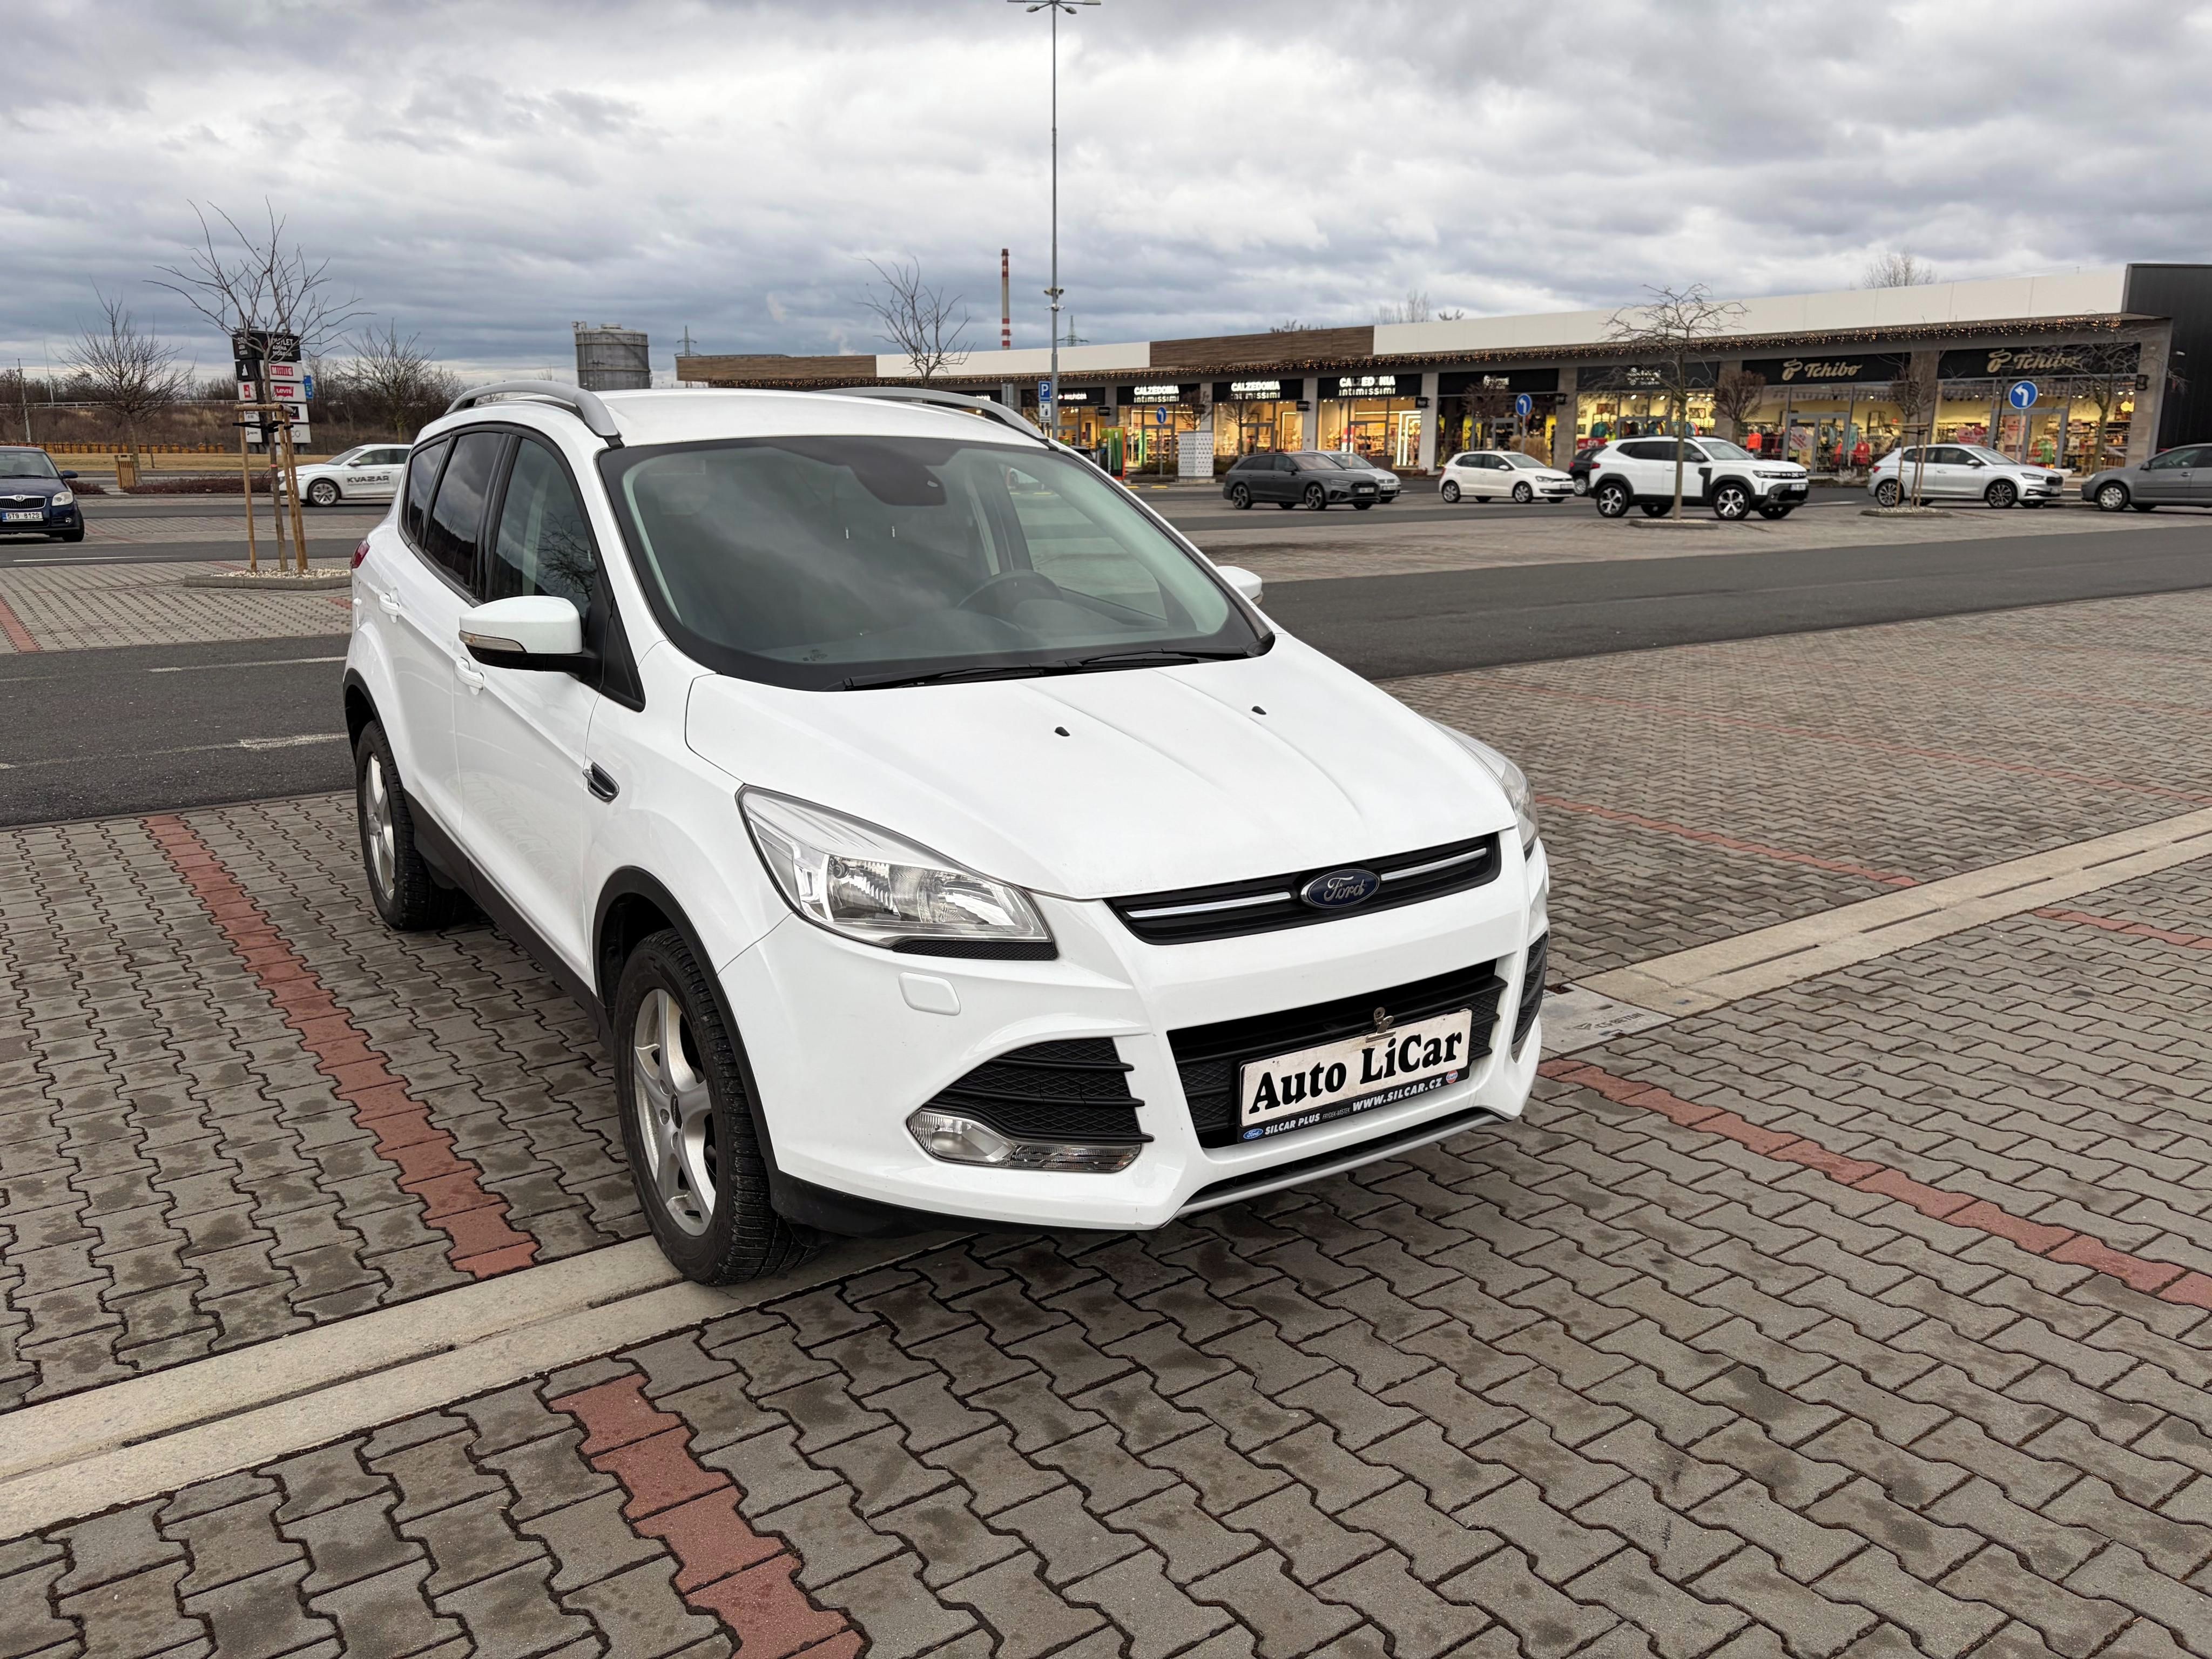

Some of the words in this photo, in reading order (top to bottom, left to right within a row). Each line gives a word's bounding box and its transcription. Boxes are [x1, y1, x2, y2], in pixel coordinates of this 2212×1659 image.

[1804, 361, 1863, 377] Tchibo
[1231, 381, 1280, 392] CALZEDONIA
[1339, 375, 1395, 387] CALZEDONIA
[1041, 383, 1049, 396] P
[1339, 387, 1396, 396] intimissimi
[1324, 875, 1366, 902] Ford
[1249, 1062, 1347, 1114] Auto
[1360, 1031, 1462, 1084] LiCar
[1265, 1120, 1296, 1135] SILCAR
[1298, 1113, 1320, 1127] PLUS
[1353, 1077, 1442, 1112] WWW.SILCAR.CZ
